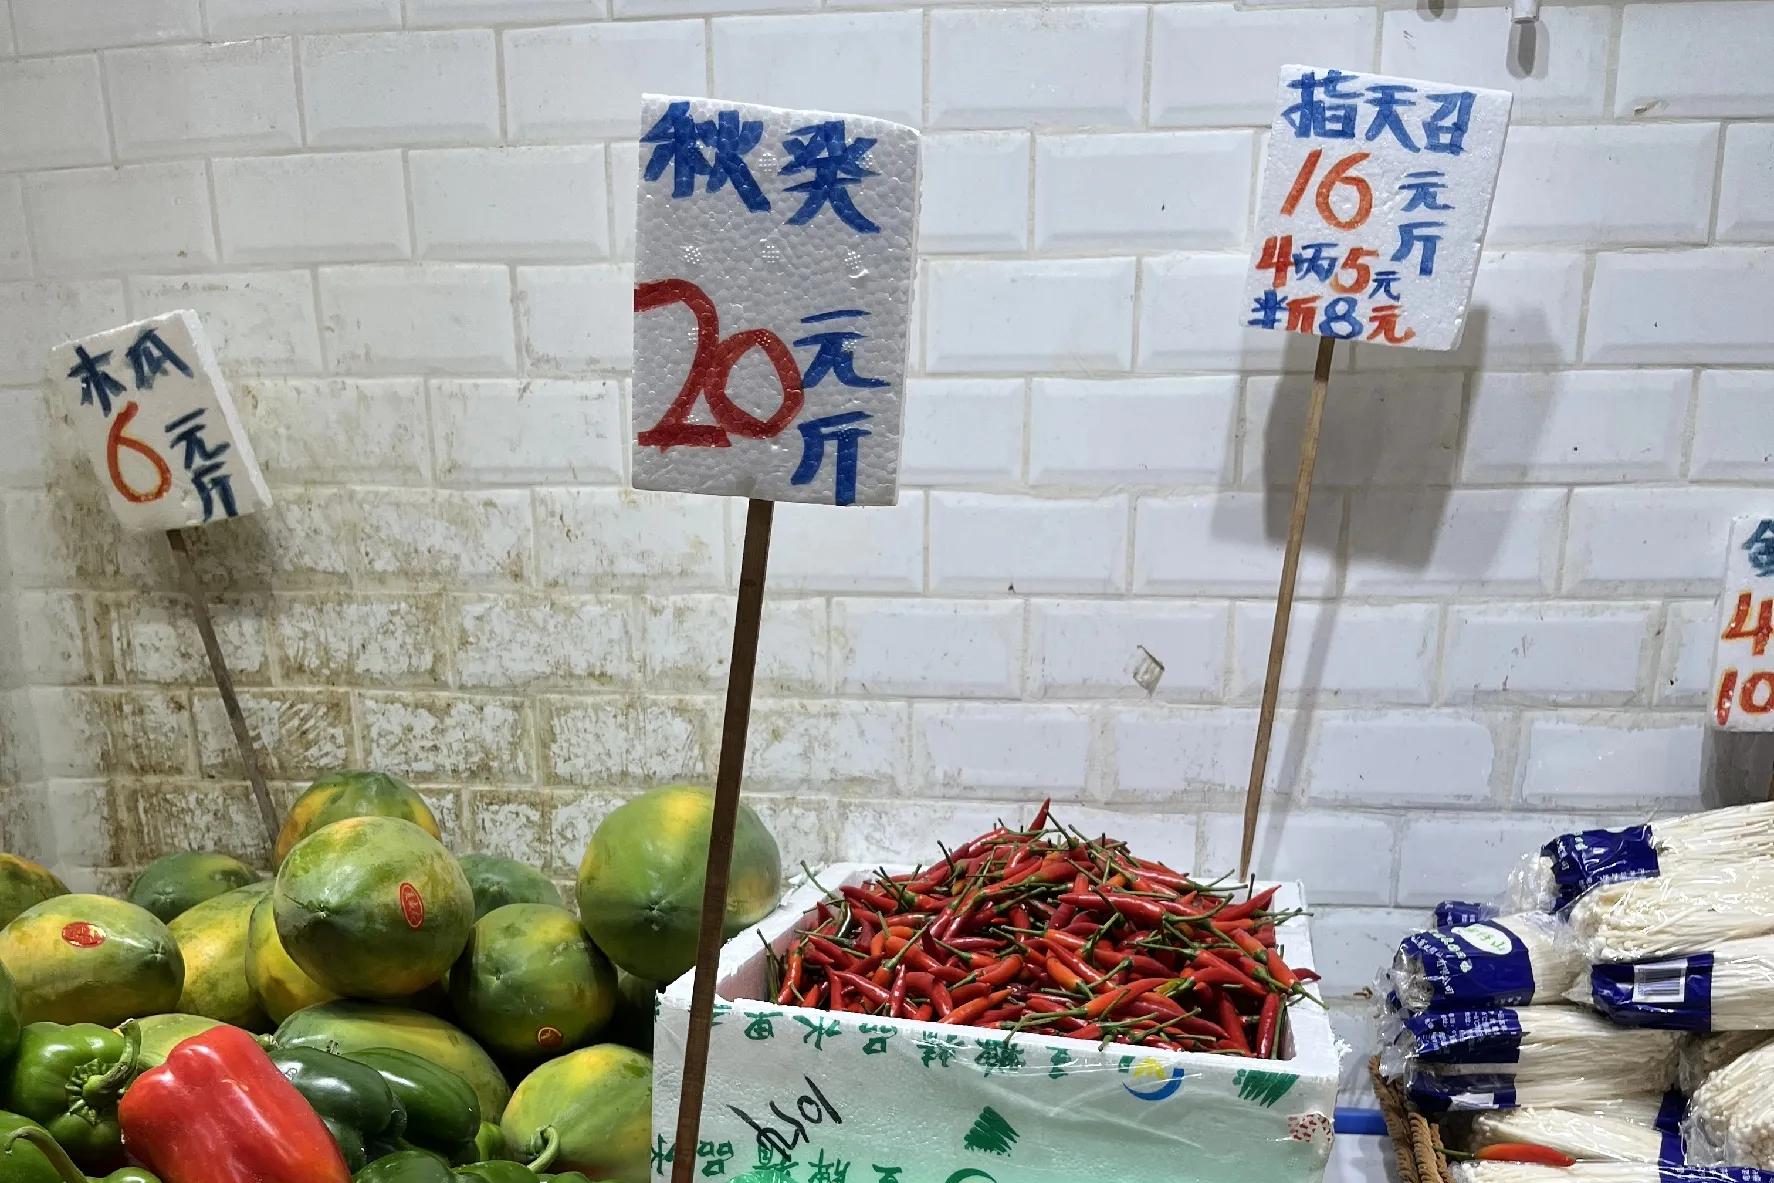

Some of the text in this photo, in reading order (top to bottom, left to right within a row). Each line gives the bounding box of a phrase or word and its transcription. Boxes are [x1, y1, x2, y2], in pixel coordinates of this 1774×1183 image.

[1280, 148, 1374, 231] 16
[66, 328, 194, 418] 木瓜
[634, 278, 805, 453] 20
[106, 400, 172, 504] 6
